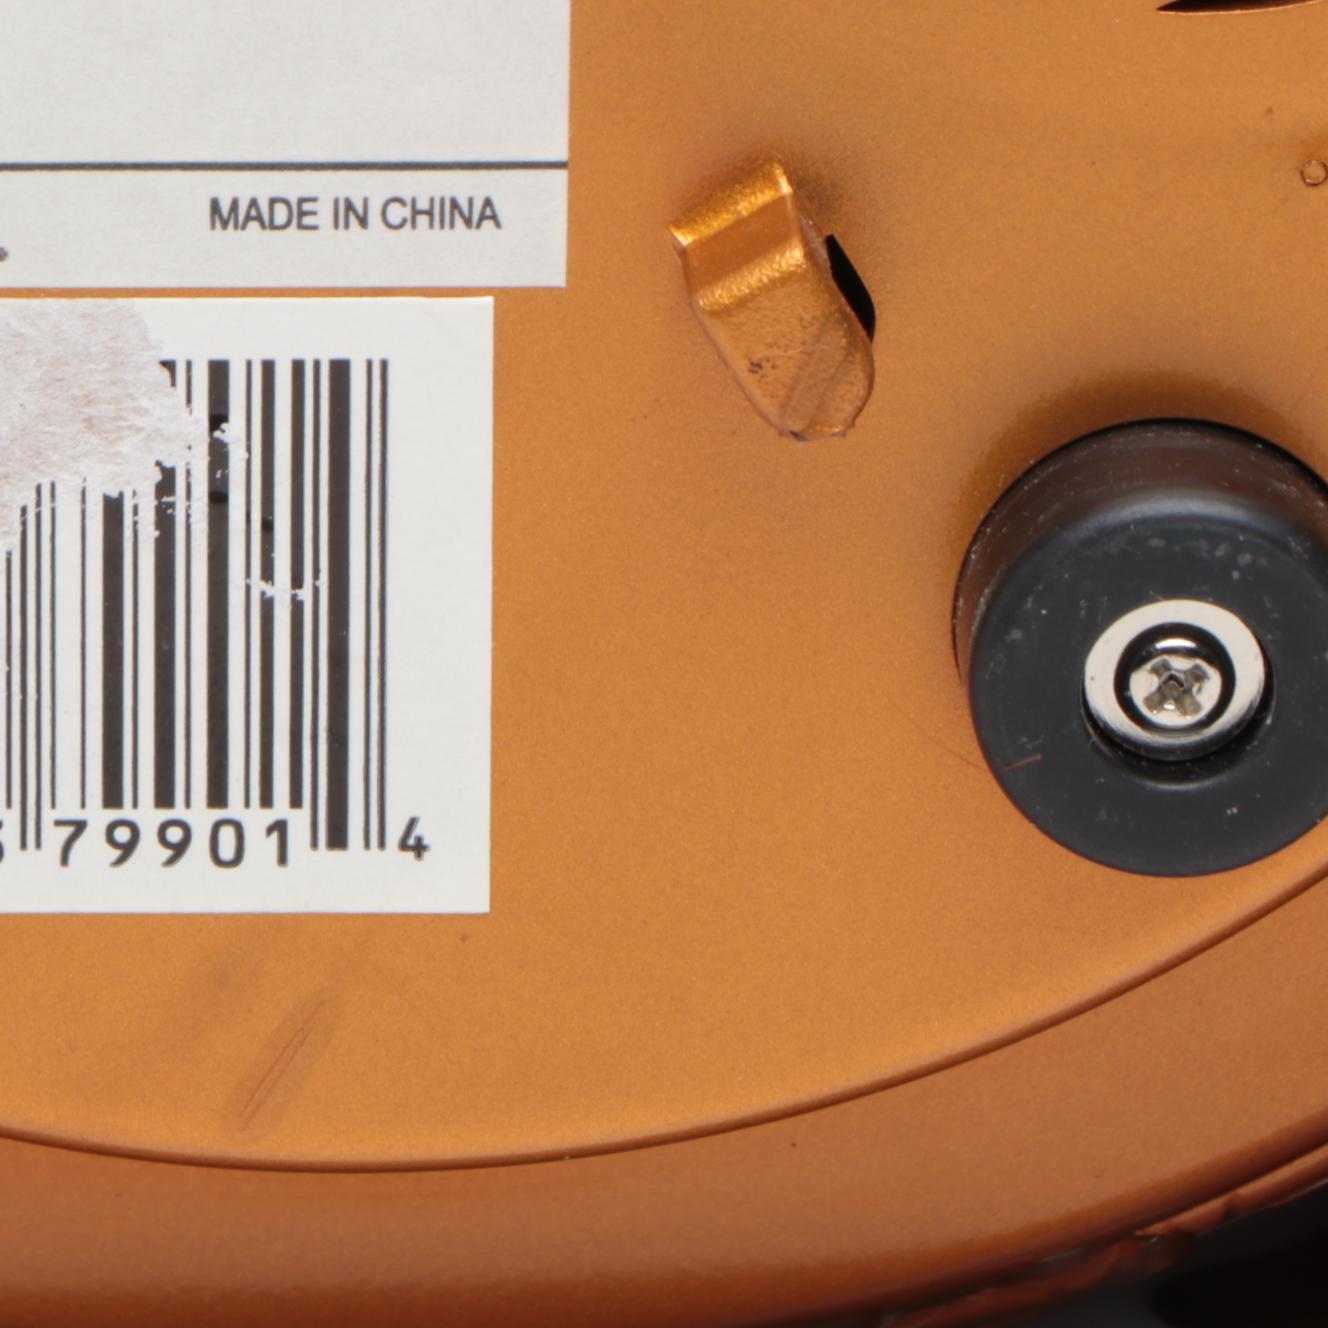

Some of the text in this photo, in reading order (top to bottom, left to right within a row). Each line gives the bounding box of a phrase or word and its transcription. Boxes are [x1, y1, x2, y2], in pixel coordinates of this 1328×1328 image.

[210, 197, 501, 230] MADE IN CHINA
[398, 817, 429, 861] 4
